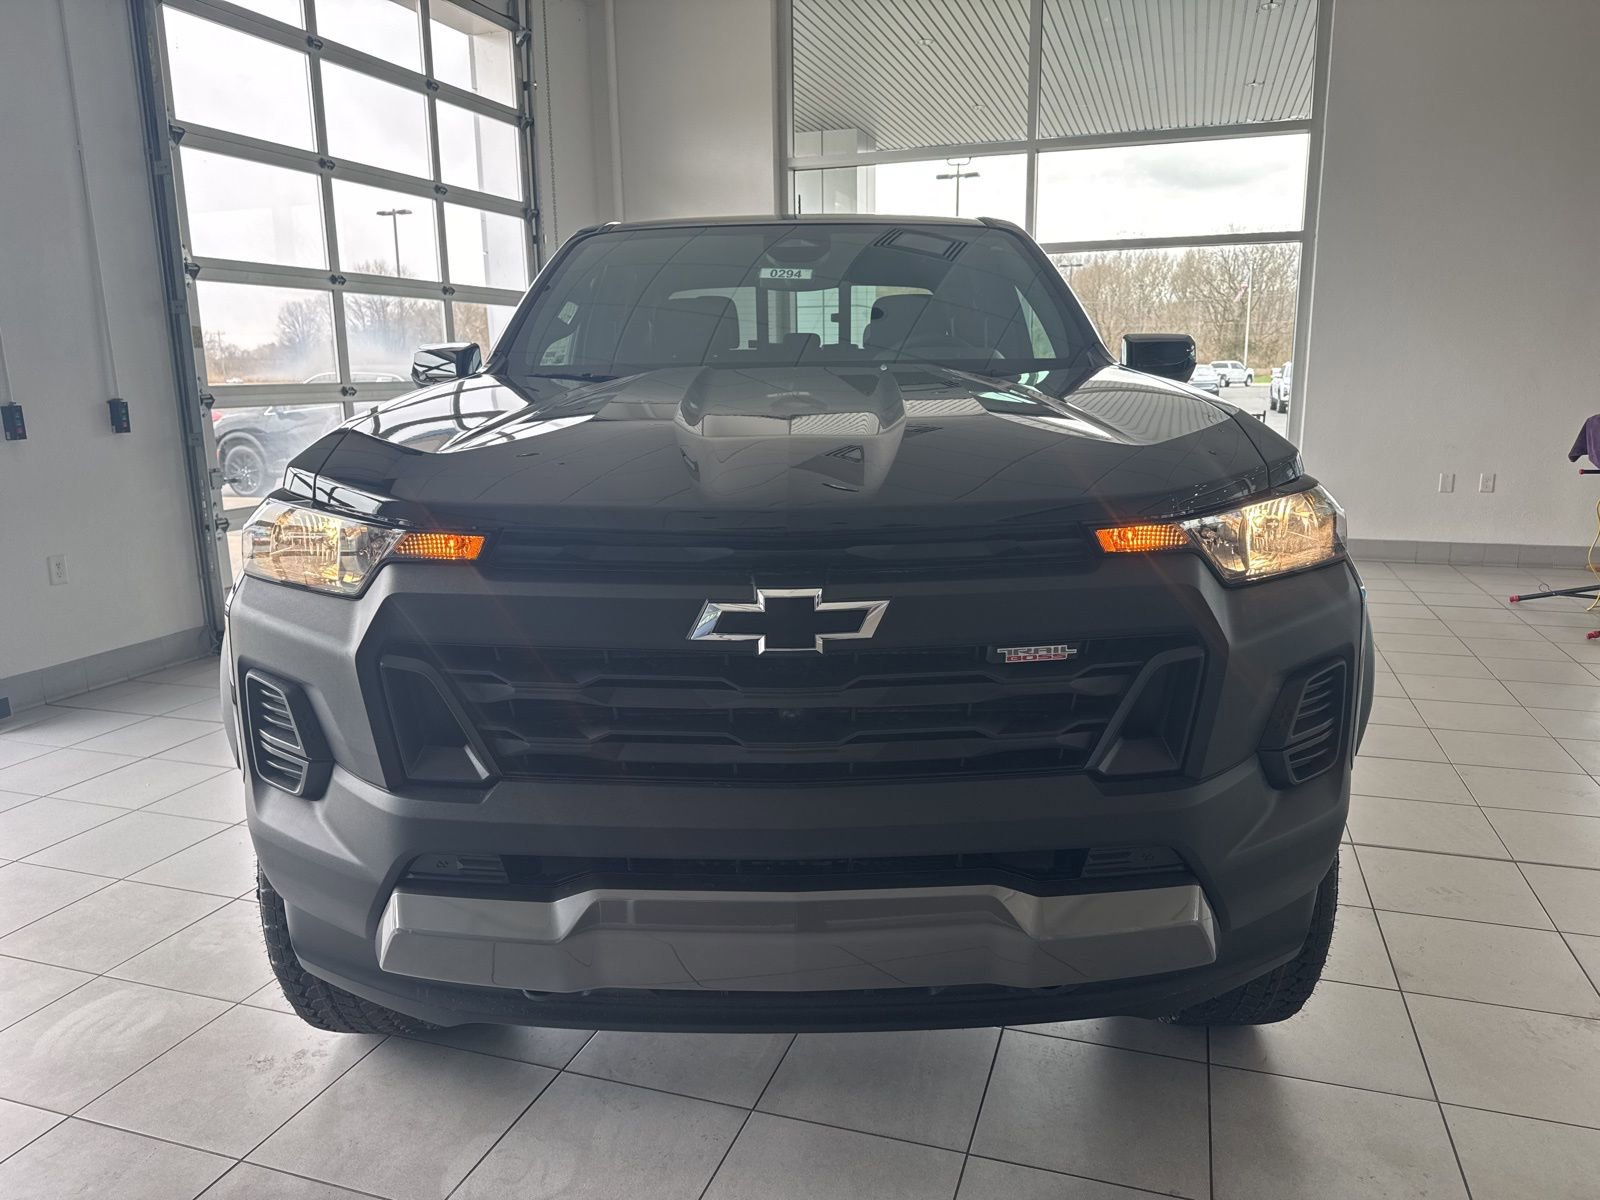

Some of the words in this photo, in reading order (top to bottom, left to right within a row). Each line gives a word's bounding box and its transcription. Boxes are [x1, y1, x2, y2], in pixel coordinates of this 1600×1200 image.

[769, 269, 802, 278] 0294
[997, 645, 1077, 656] TRAIL
[1005, 654, 1067, 663] BOSS
